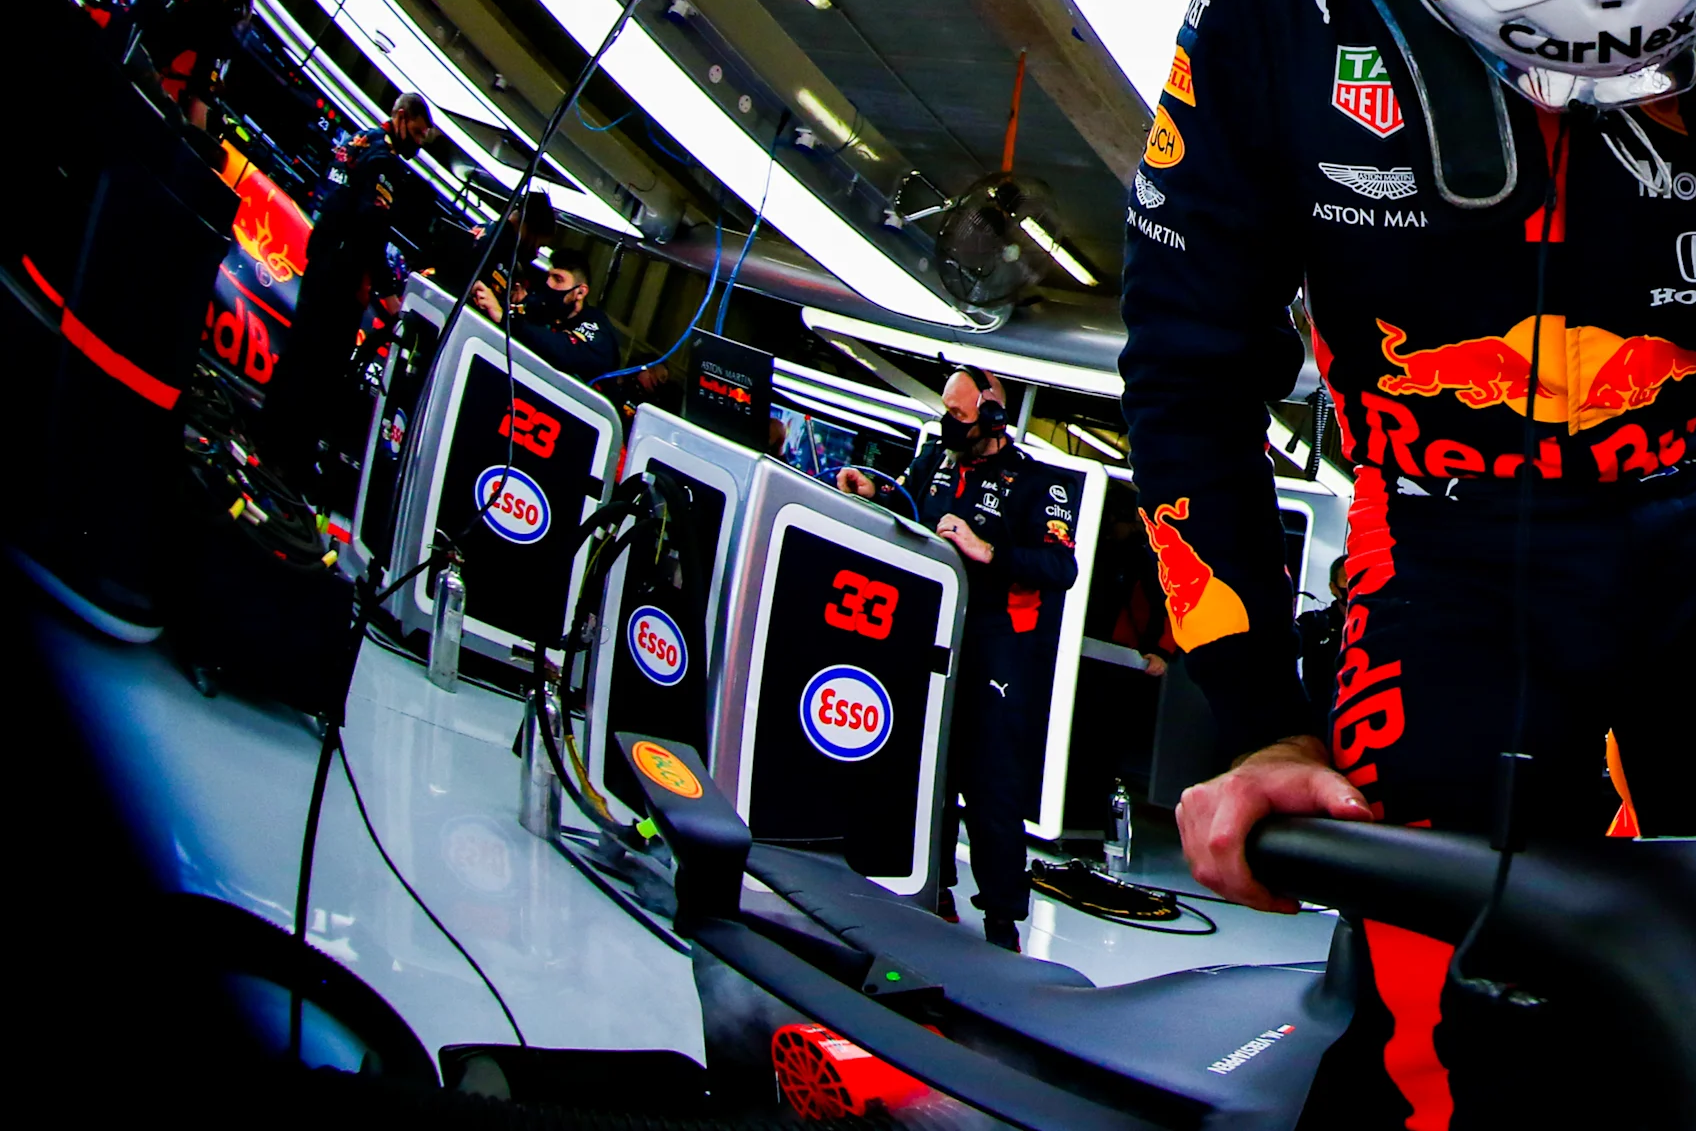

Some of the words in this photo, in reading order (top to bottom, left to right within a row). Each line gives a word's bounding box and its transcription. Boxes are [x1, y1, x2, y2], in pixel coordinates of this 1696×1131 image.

[1345, 53, 1388, 79] TA
[1150, 123, 1175, 158] UCH
[1358, 172, 1383, 181] ASTON
[1312, 201, 1375, 227] ASTON
[1138, 215, 1186, 251] MARTIN
[701, 361, 723, 375] ASTON
[725, 368, 752, 387] MARTIN
[498, 397, 562, 458] 23
[1361, 389, 1564, 479] Red
[824, 569, 899, 640] 33
[818, 688, 879, 733] Esso
[1206, 1037, 1276, 1075] VERSTAPPEN
